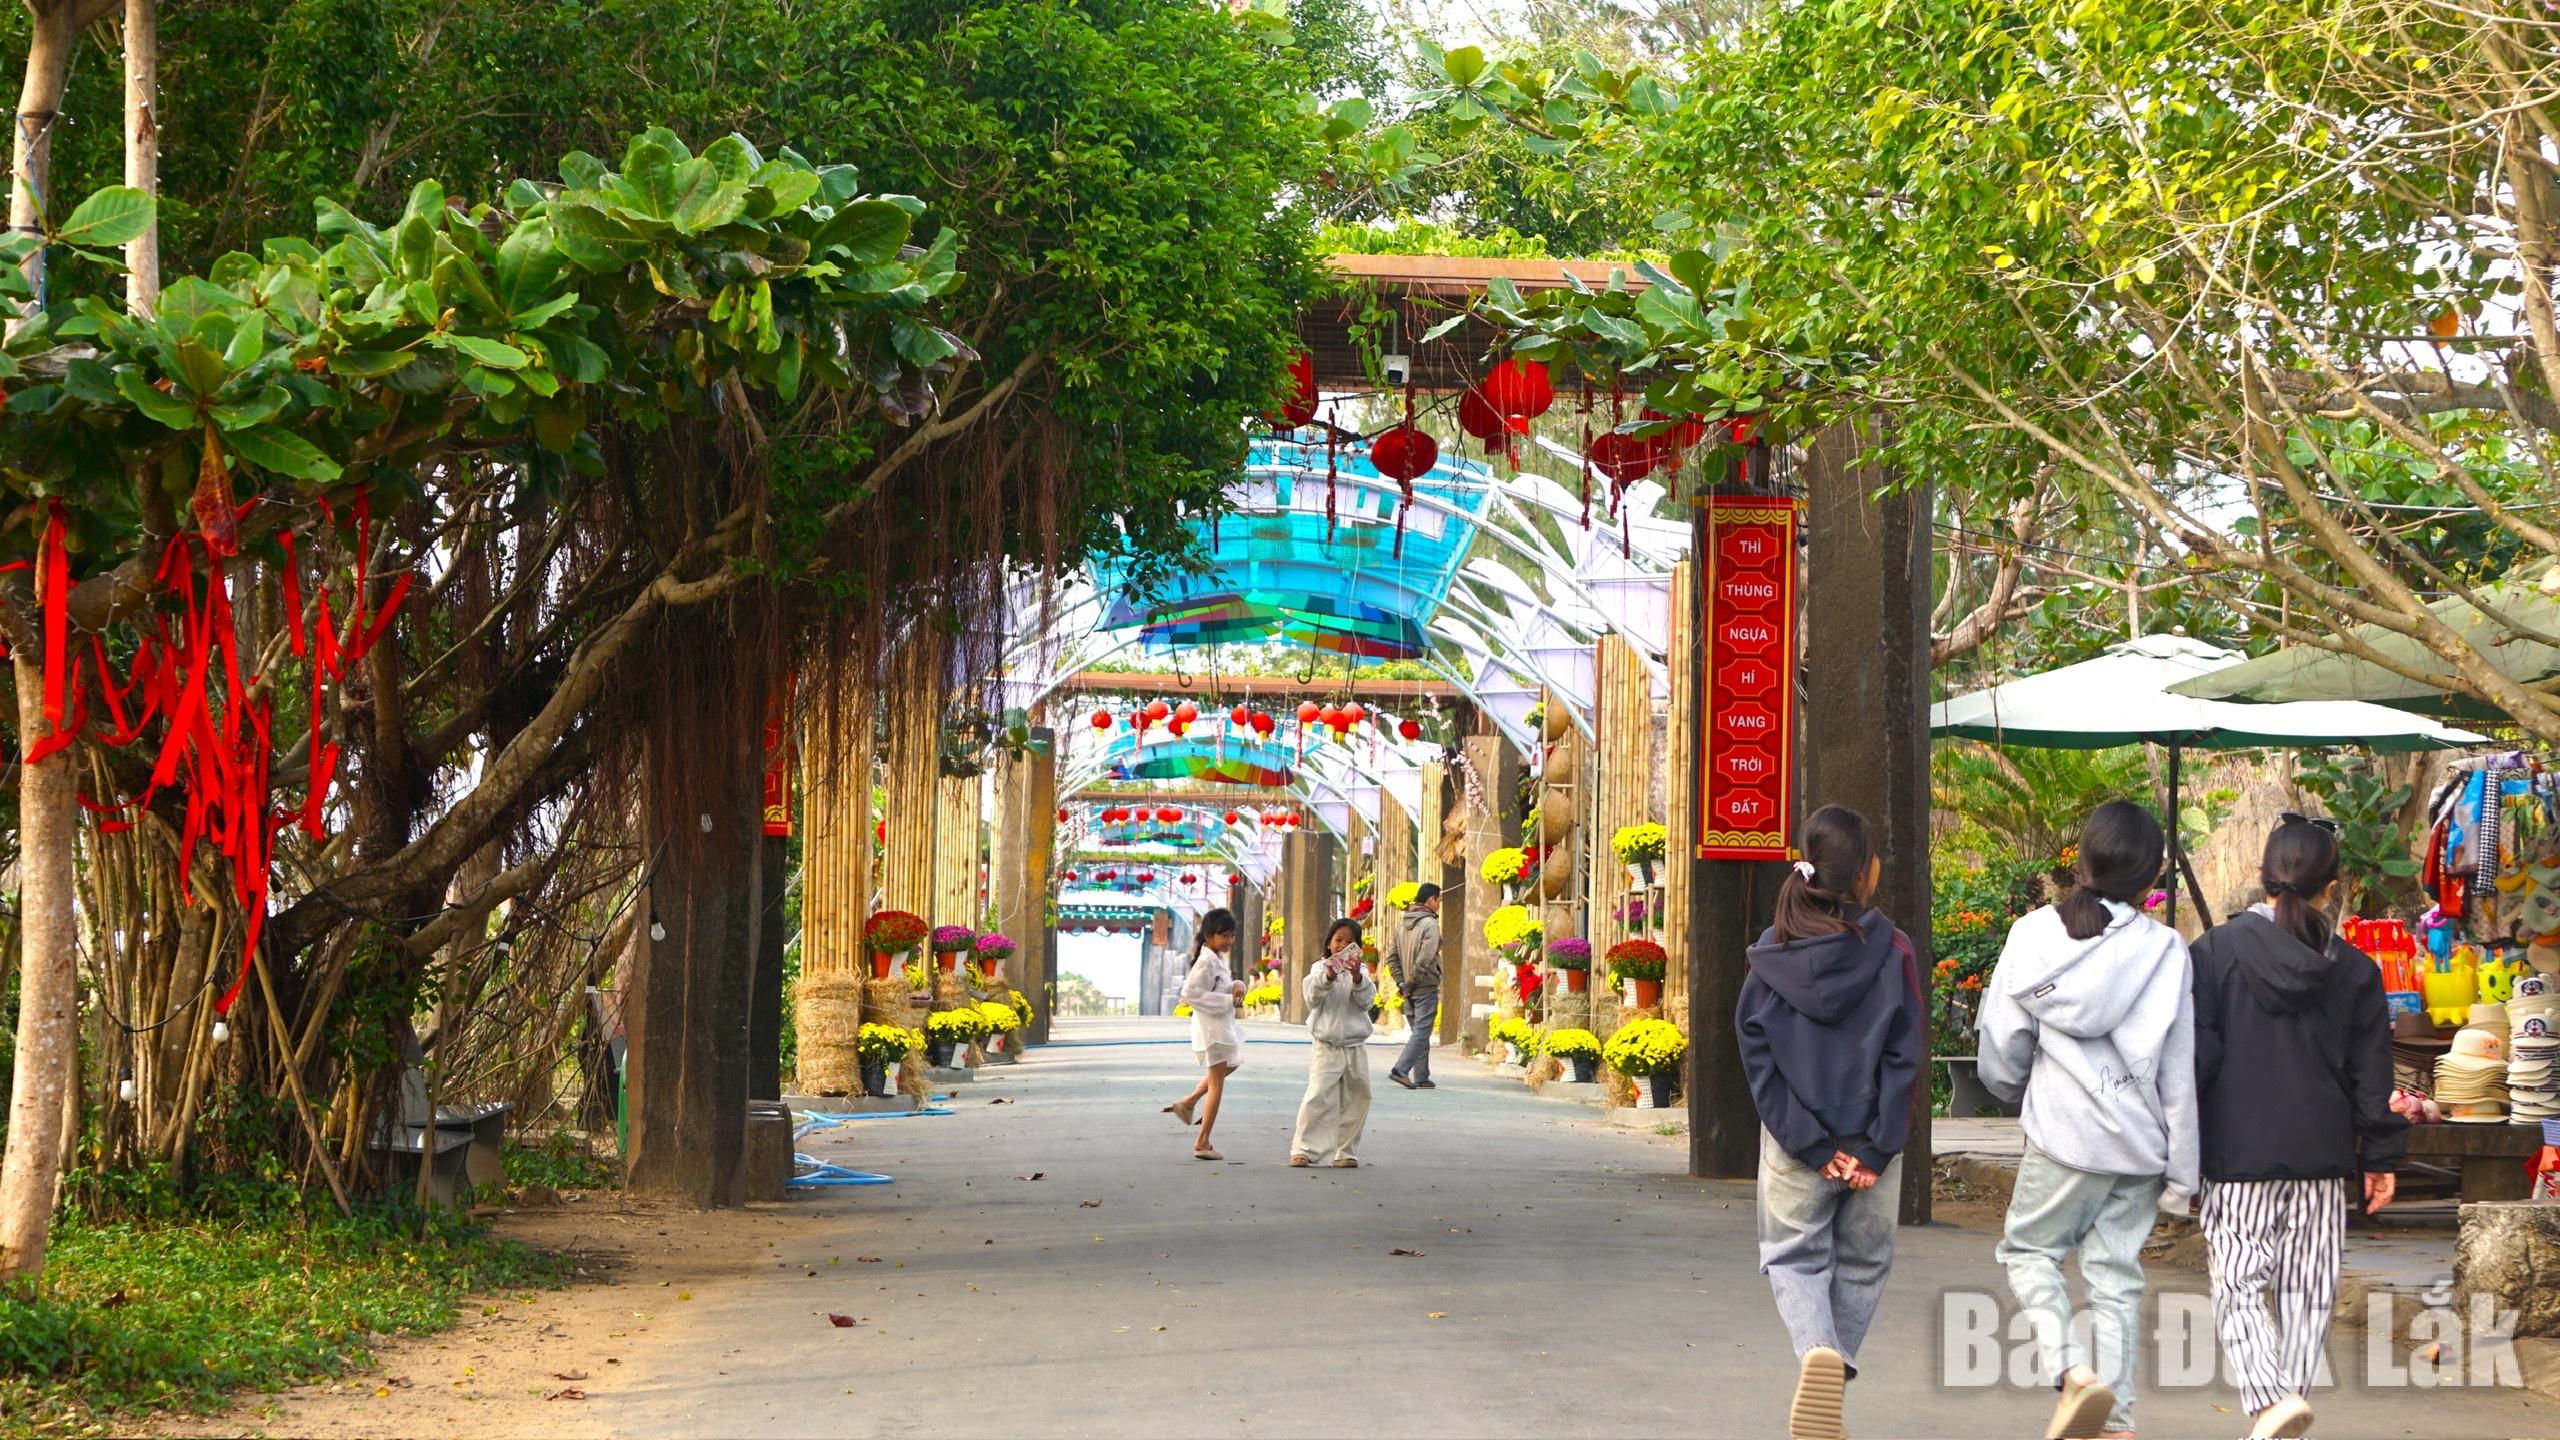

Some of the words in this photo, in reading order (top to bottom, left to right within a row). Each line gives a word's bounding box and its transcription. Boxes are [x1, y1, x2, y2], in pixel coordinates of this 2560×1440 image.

[1739, 538, 1761, 554] THÌ
[1726, 582, 1773, 597] THÙNG
[1729, 627, 1768, 642] NGỰA
[1741, 669, 1756, 684] HÍ
[1728, 715, 1766, 728] VANG
[1730, 755, 1762, 771] TRỜI
[1731, 797, 1759, 814] ĐẤT
